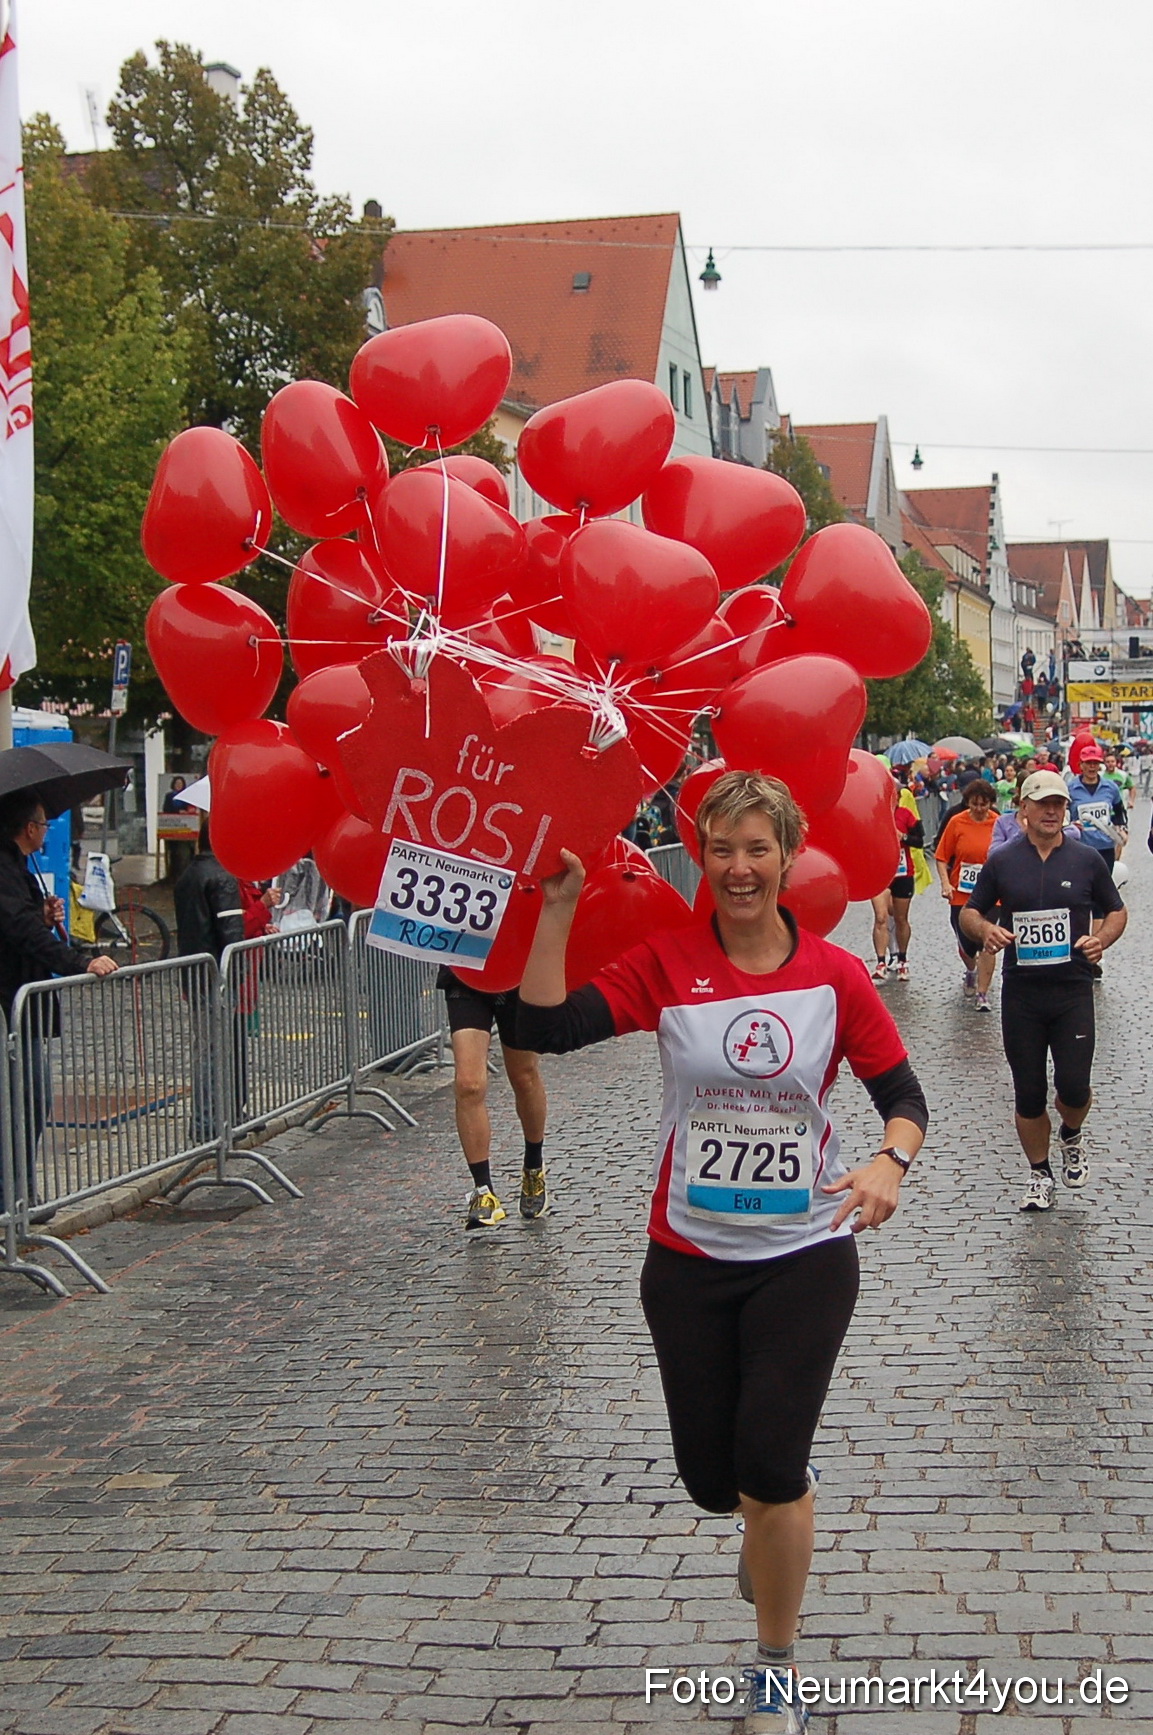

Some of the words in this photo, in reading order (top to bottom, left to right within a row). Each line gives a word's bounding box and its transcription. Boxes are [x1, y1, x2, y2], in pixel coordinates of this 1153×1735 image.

[457, 734, 515, 785] für
[381, 767, 552, 875] ROSI
[391, 846, 432, 868] PARTL
[435, 858, 494, 885] Neumarkt
[389, 867, 498, 931] 3333
[1018, 922, 1066, 945] 2568
[695, 1086, 744, 1098] LAUFEN
[749, 1089, 773, 1099] MIT
[777, 1091, 811, 1102] HERZ
[707, 1102, 721, 1111] Dr.
[753, 1104, 767, 1112] Dr.
[690, 1120, 732, 1134] PARTL
[734, 1124, 790, 1136] Neumarkt
[699, 1138, 801, 1183] 2725
[733, 1193, 762, 1211] Eva
